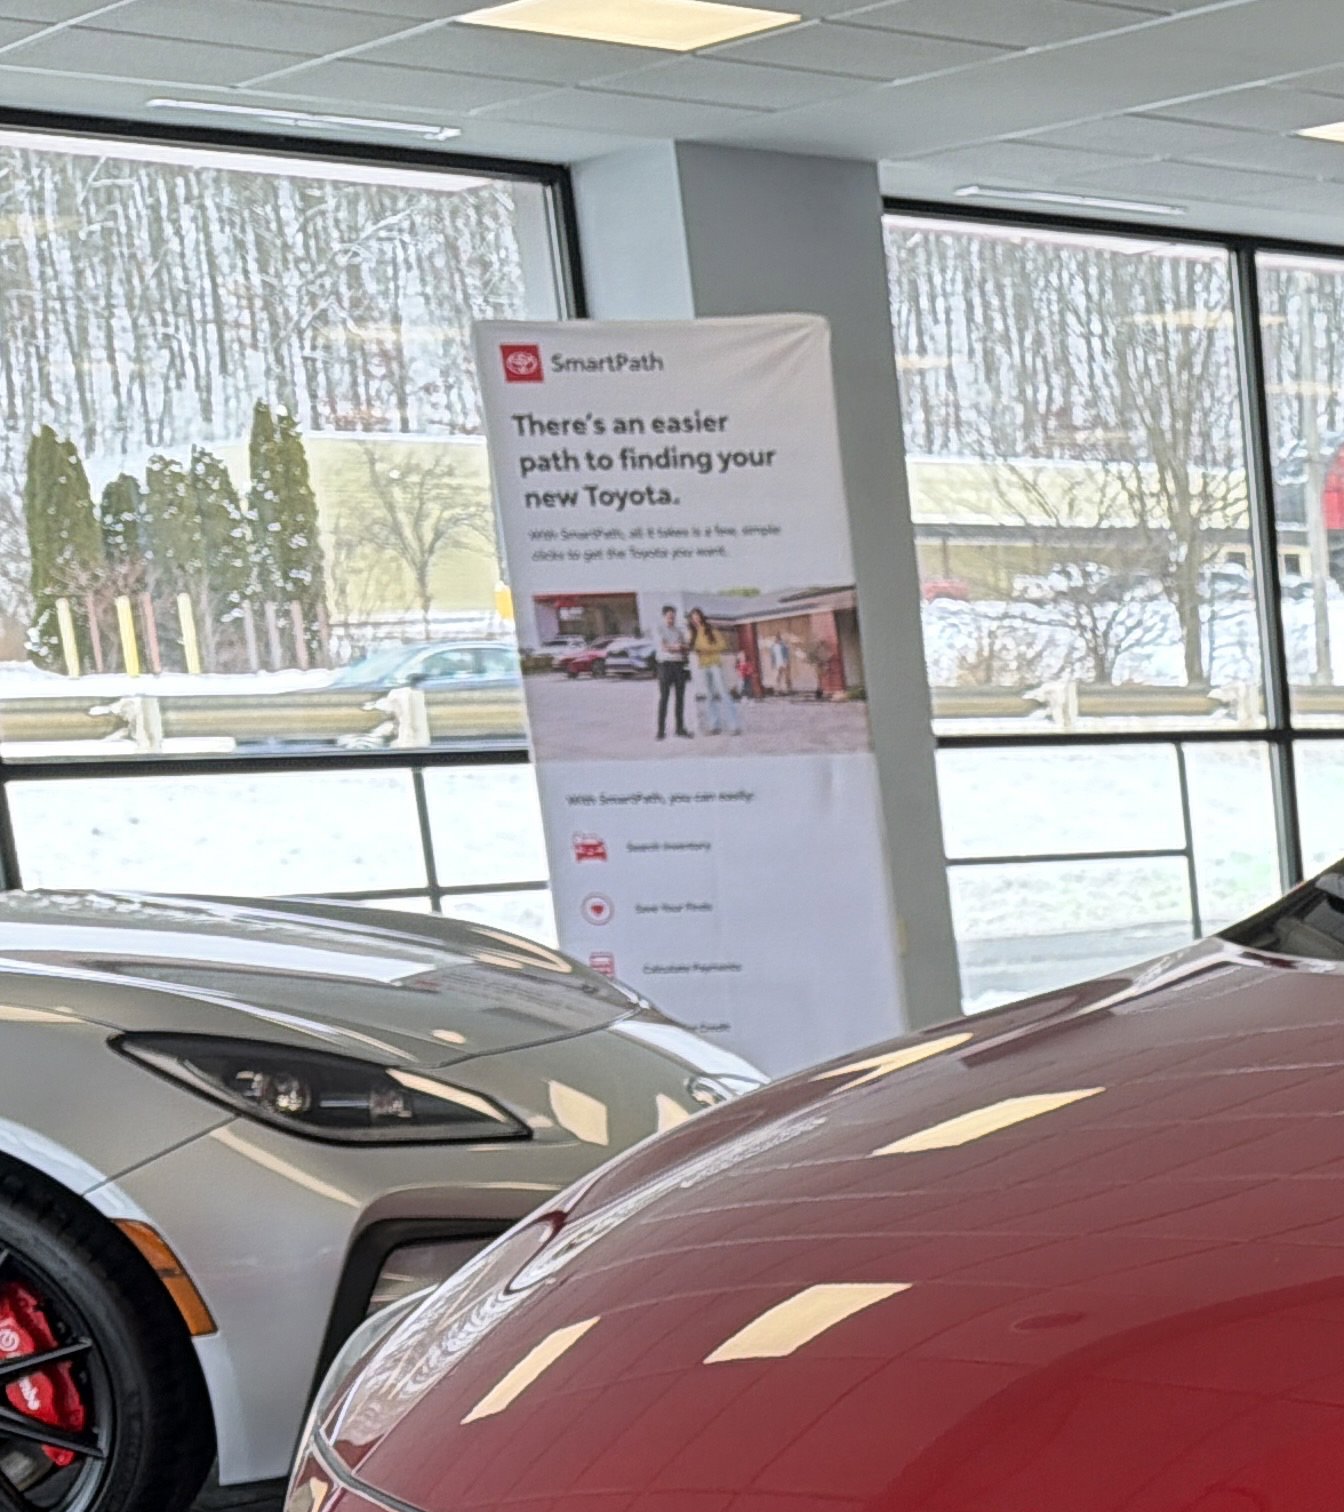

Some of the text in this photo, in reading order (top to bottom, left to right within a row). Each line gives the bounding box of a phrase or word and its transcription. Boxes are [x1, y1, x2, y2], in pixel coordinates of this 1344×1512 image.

[550, 351, 664, 374] SmartPath
[511, 409, 729, 437] There's an easier
[519, 445, 777, 479] path to finding your
[525, 483, 681, 512] new Toyota.
